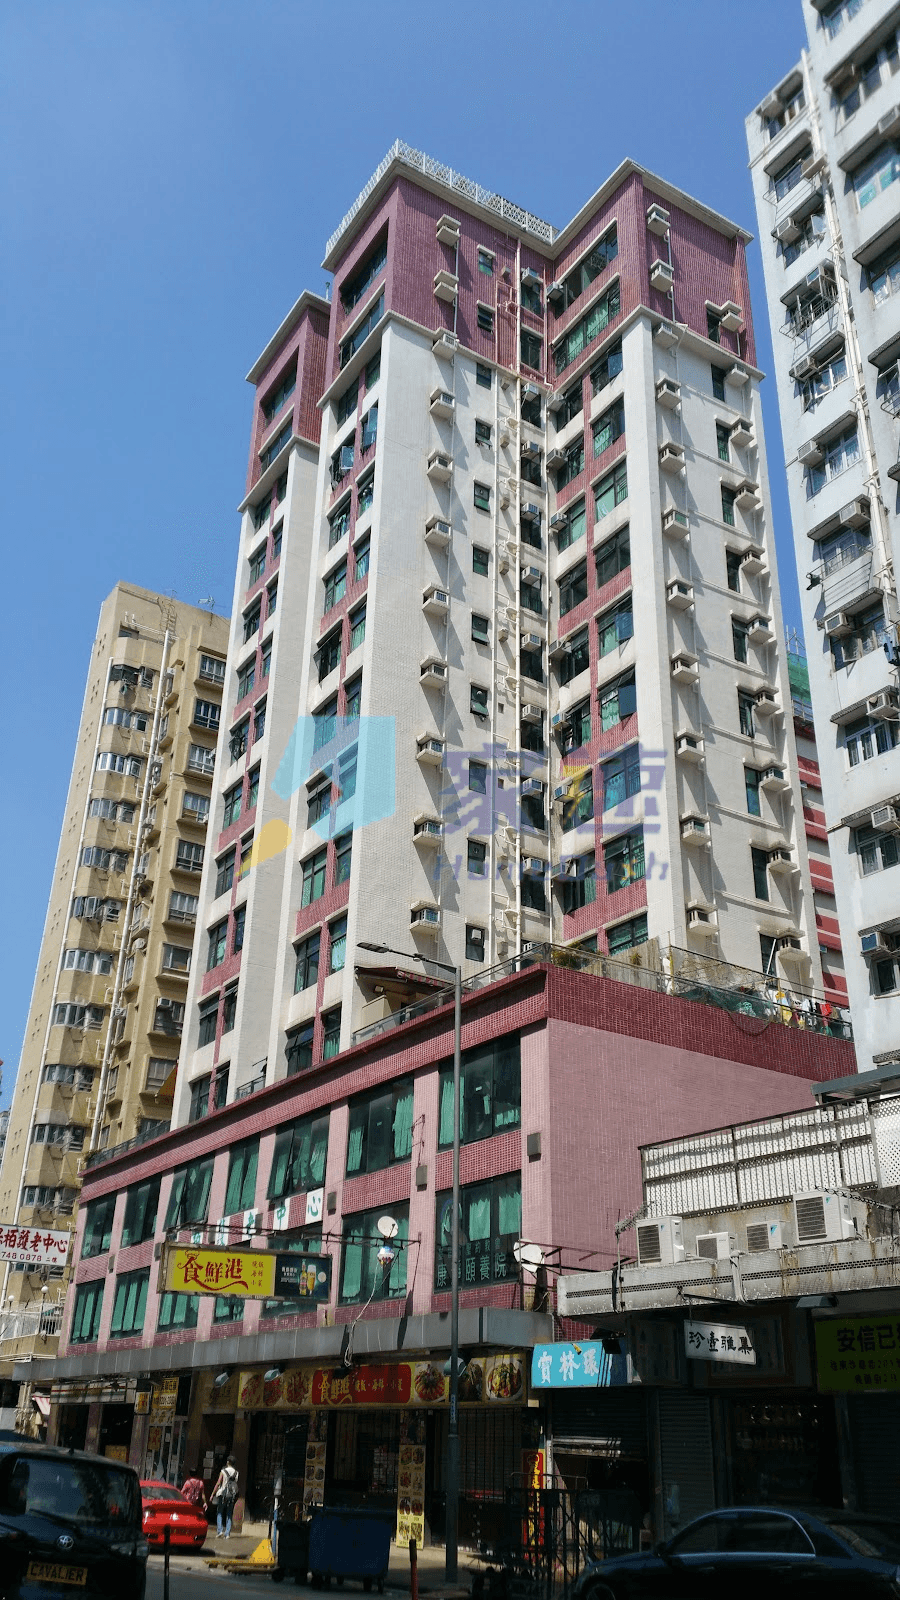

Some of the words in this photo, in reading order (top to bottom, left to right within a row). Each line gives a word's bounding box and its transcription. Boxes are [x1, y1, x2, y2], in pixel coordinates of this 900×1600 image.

[178, 1250, 249, 1291] 食鮮港
[837, 1323, 900, 1353] 安信已
[29, 1562, 84, 1582] CAVALIER
